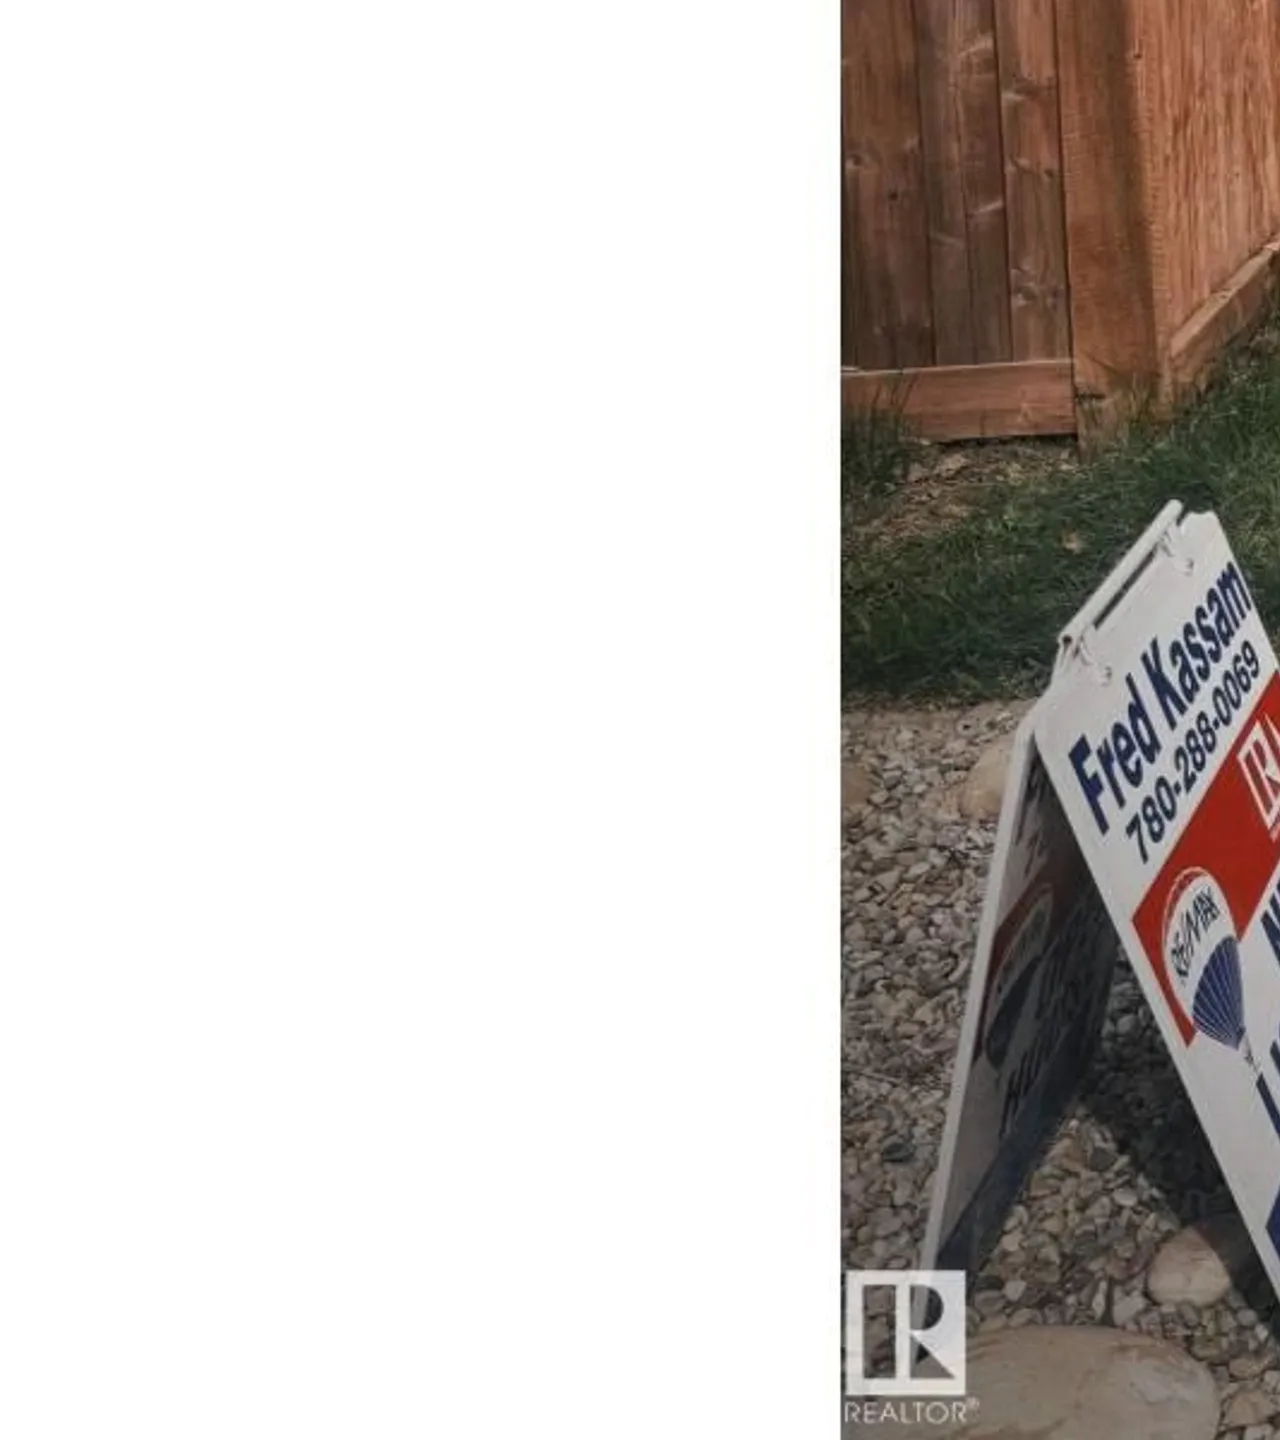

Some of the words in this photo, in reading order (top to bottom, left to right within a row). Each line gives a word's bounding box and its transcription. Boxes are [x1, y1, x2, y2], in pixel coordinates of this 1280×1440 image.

[1068, 671, 1163, 836] Fred
[1140, 562, 1252, 732] Kassam
[1125, 640, 1261, 865] 780-288-0069
